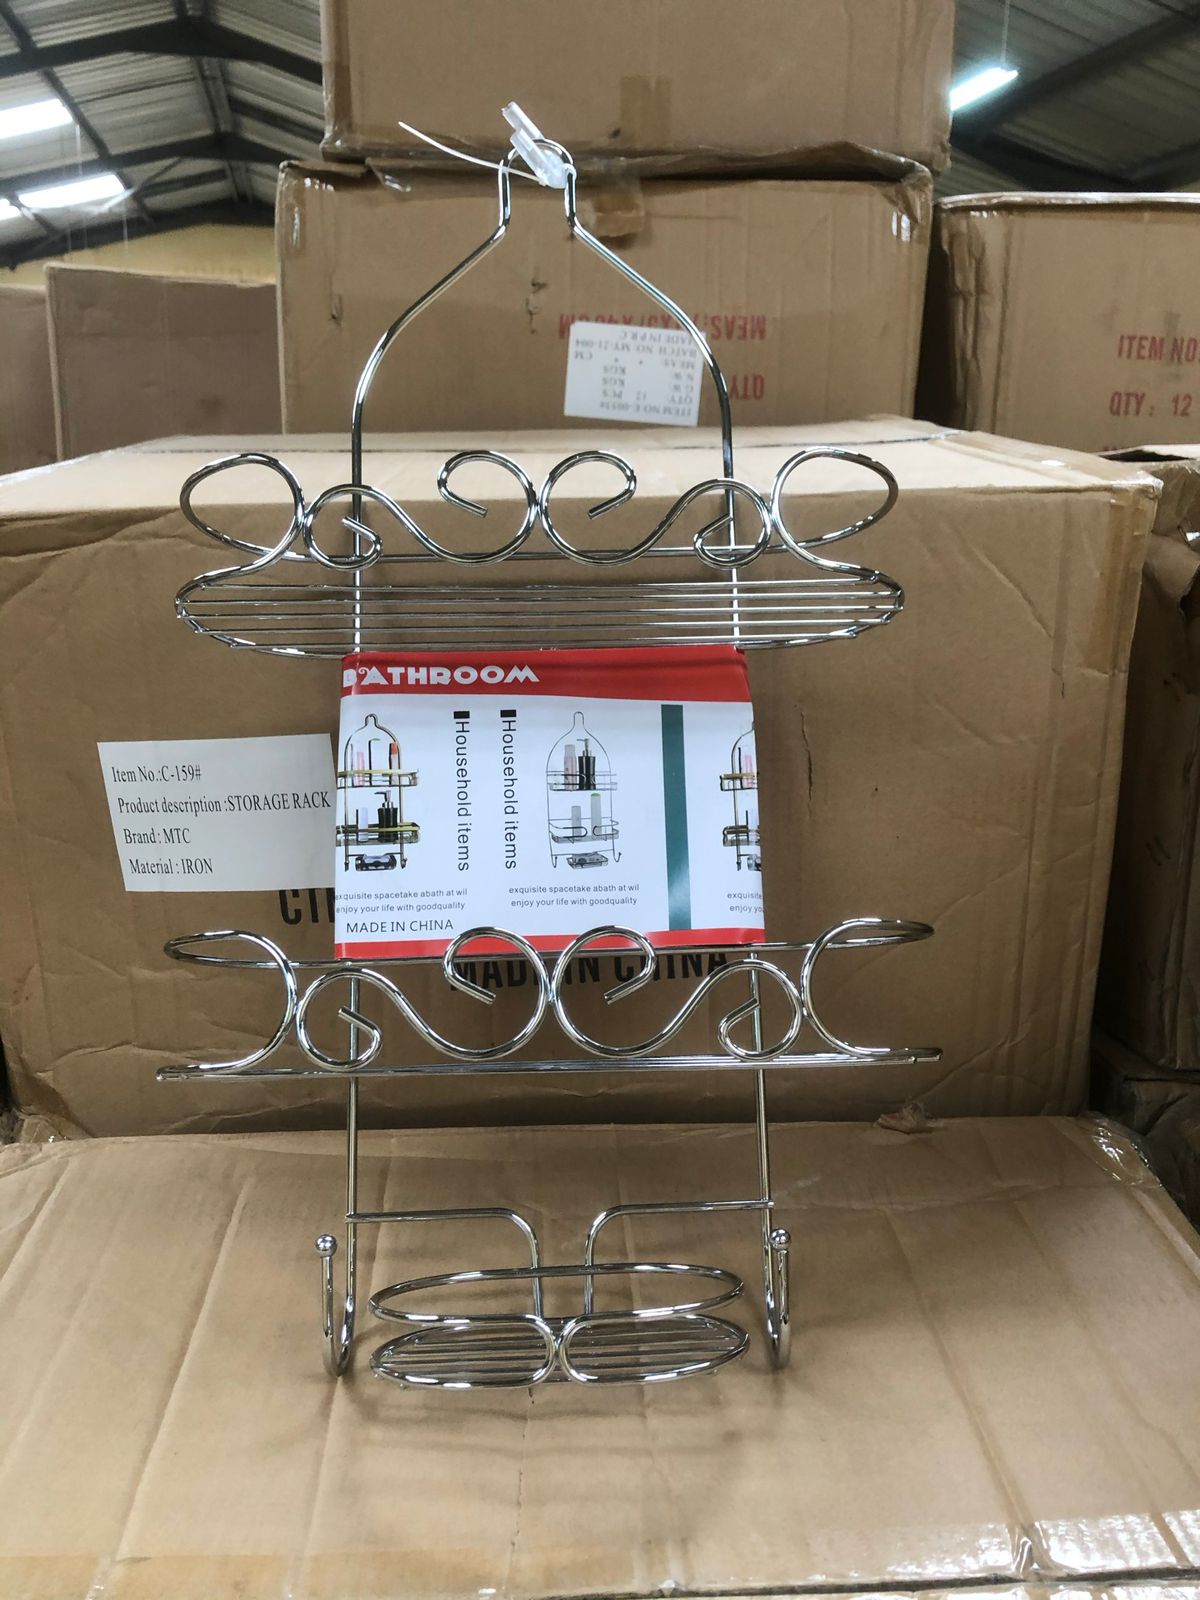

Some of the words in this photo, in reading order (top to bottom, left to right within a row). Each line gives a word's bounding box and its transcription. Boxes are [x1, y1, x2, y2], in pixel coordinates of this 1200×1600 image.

[1117, 335, 1165, 360] ITEM
[1172, 393, 1192, 417] 12
[343, 664, 540, 688] BATHROOM
[112, 766, 137, 783] Item
[455, 721, 472, 818] Household
[502, 720, 519, 815] Household
[118, 797, 160, 814] Product
[161, 795, 222, 817] description
[292, 791, 331, 809] RACK
[163, 827, 191, 844] MTC
[457, 823, 472, 872] items
[504, 821, 519, 870] items
[129, 858, 173, 874] Material
[182, 857, 213, 874] IRON
[374, 889, 418, 901] spacetake
[420, 888, 444, 898] abath
[446, 889, 454, 897] at
[456, 887, 468, 896] wil
[509, 885, 547, 895] exquisite
[549, 884, 592, 894] spacetake
[593, 883, 616, 892] abath
[618, 884, 627, 892] at
[628, 883, 640, 891] wil
[336, 904, 358, 915] enjoy
[360, 904, 380, 914] your
[382, 903, 395, 912] life
[396, 903, 414, 912] with
[416, 901, 466, 912] goodquality
[511, 898, 534, 908] enjoy
[536, 899, 554, 908] your
[556, 897, 569, 906] life
[570, 897, 588, 906] with
[589, 896, 638, 906] goodquality
[729, 904, 752, 913] enjoy
[346, 921, 387, 933] MADE
[391, 921, 405, 932] IN
[409, 919, 454, 932] CHINA
